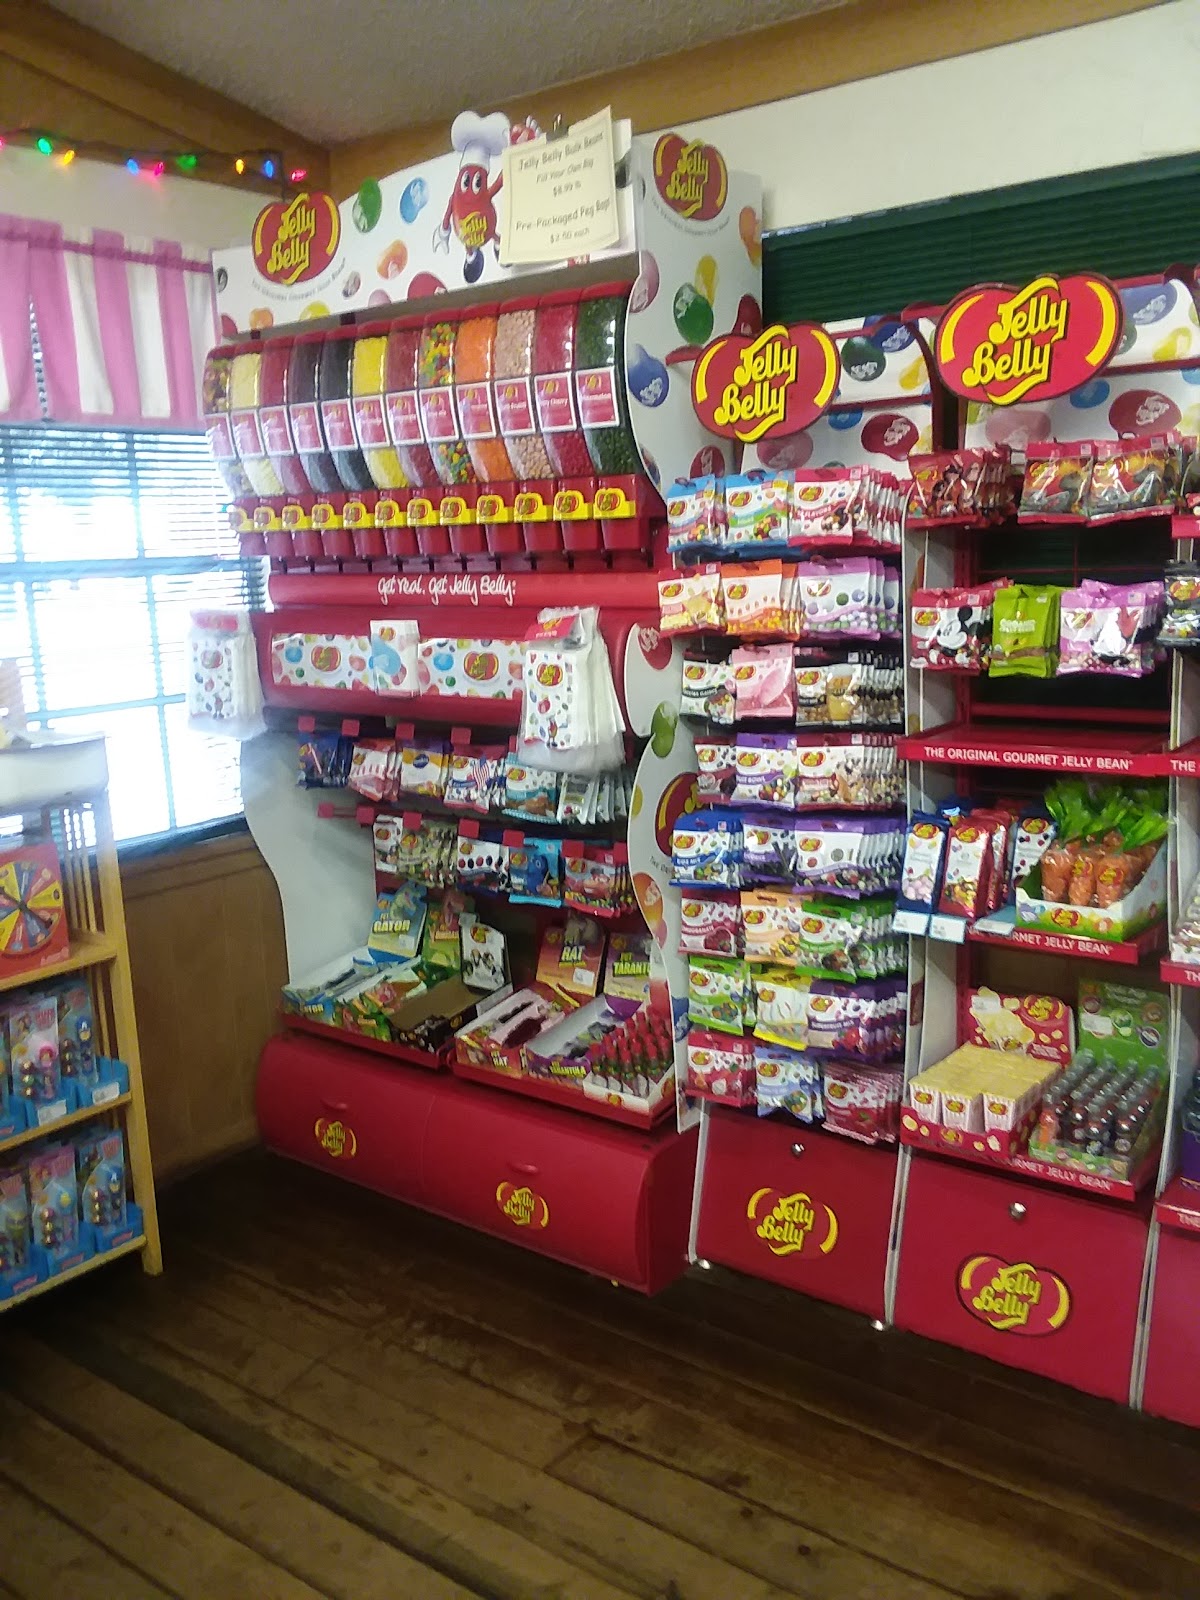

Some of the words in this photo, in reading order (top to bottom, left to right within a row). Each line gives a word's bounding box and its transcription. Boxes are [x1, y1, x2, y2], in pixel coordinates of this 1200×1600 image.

[519, 157, 540, 171] Jelly
[542, 148, 563, 163] Belly
[564, 141, 582, 156] Bulk
[567, 163, 582, 174] Own
[278, 193, 316, 241] Jelly
[580, 203, 595, 217] Peg
[266, 239, 310, 286] Belly
[988, 276, 1069, 345] Jelly
[733, 324, 798, 387] Jelly
[961, 337, 1052, 406] Belly
[713, 380, 787, 444] Belly
[449, 574, 479, 607] Jelly
[924, 746, 945, 758] THE
[947, 748, 1001, 763] ORIGINAL
[1003, 751, 1060, 766] GOURMET
[1061, 755, 1094, 769] JELLY
[1170, 759, 1197, 773] THE
[373, 920, 411, 934] GATOR
[1044, 935, 1075, 951] JELLY
[562, 945, 586, 962] RAT
[1046, 1165, 1077, 1182] JELLY
[772, 1192, 815, 1232] Jelly
[756, 1214, 805, 1257] Belly
[991, 1262, 1042, 1305] Jelly
[972, 1285, 1029, 1331] Belly
